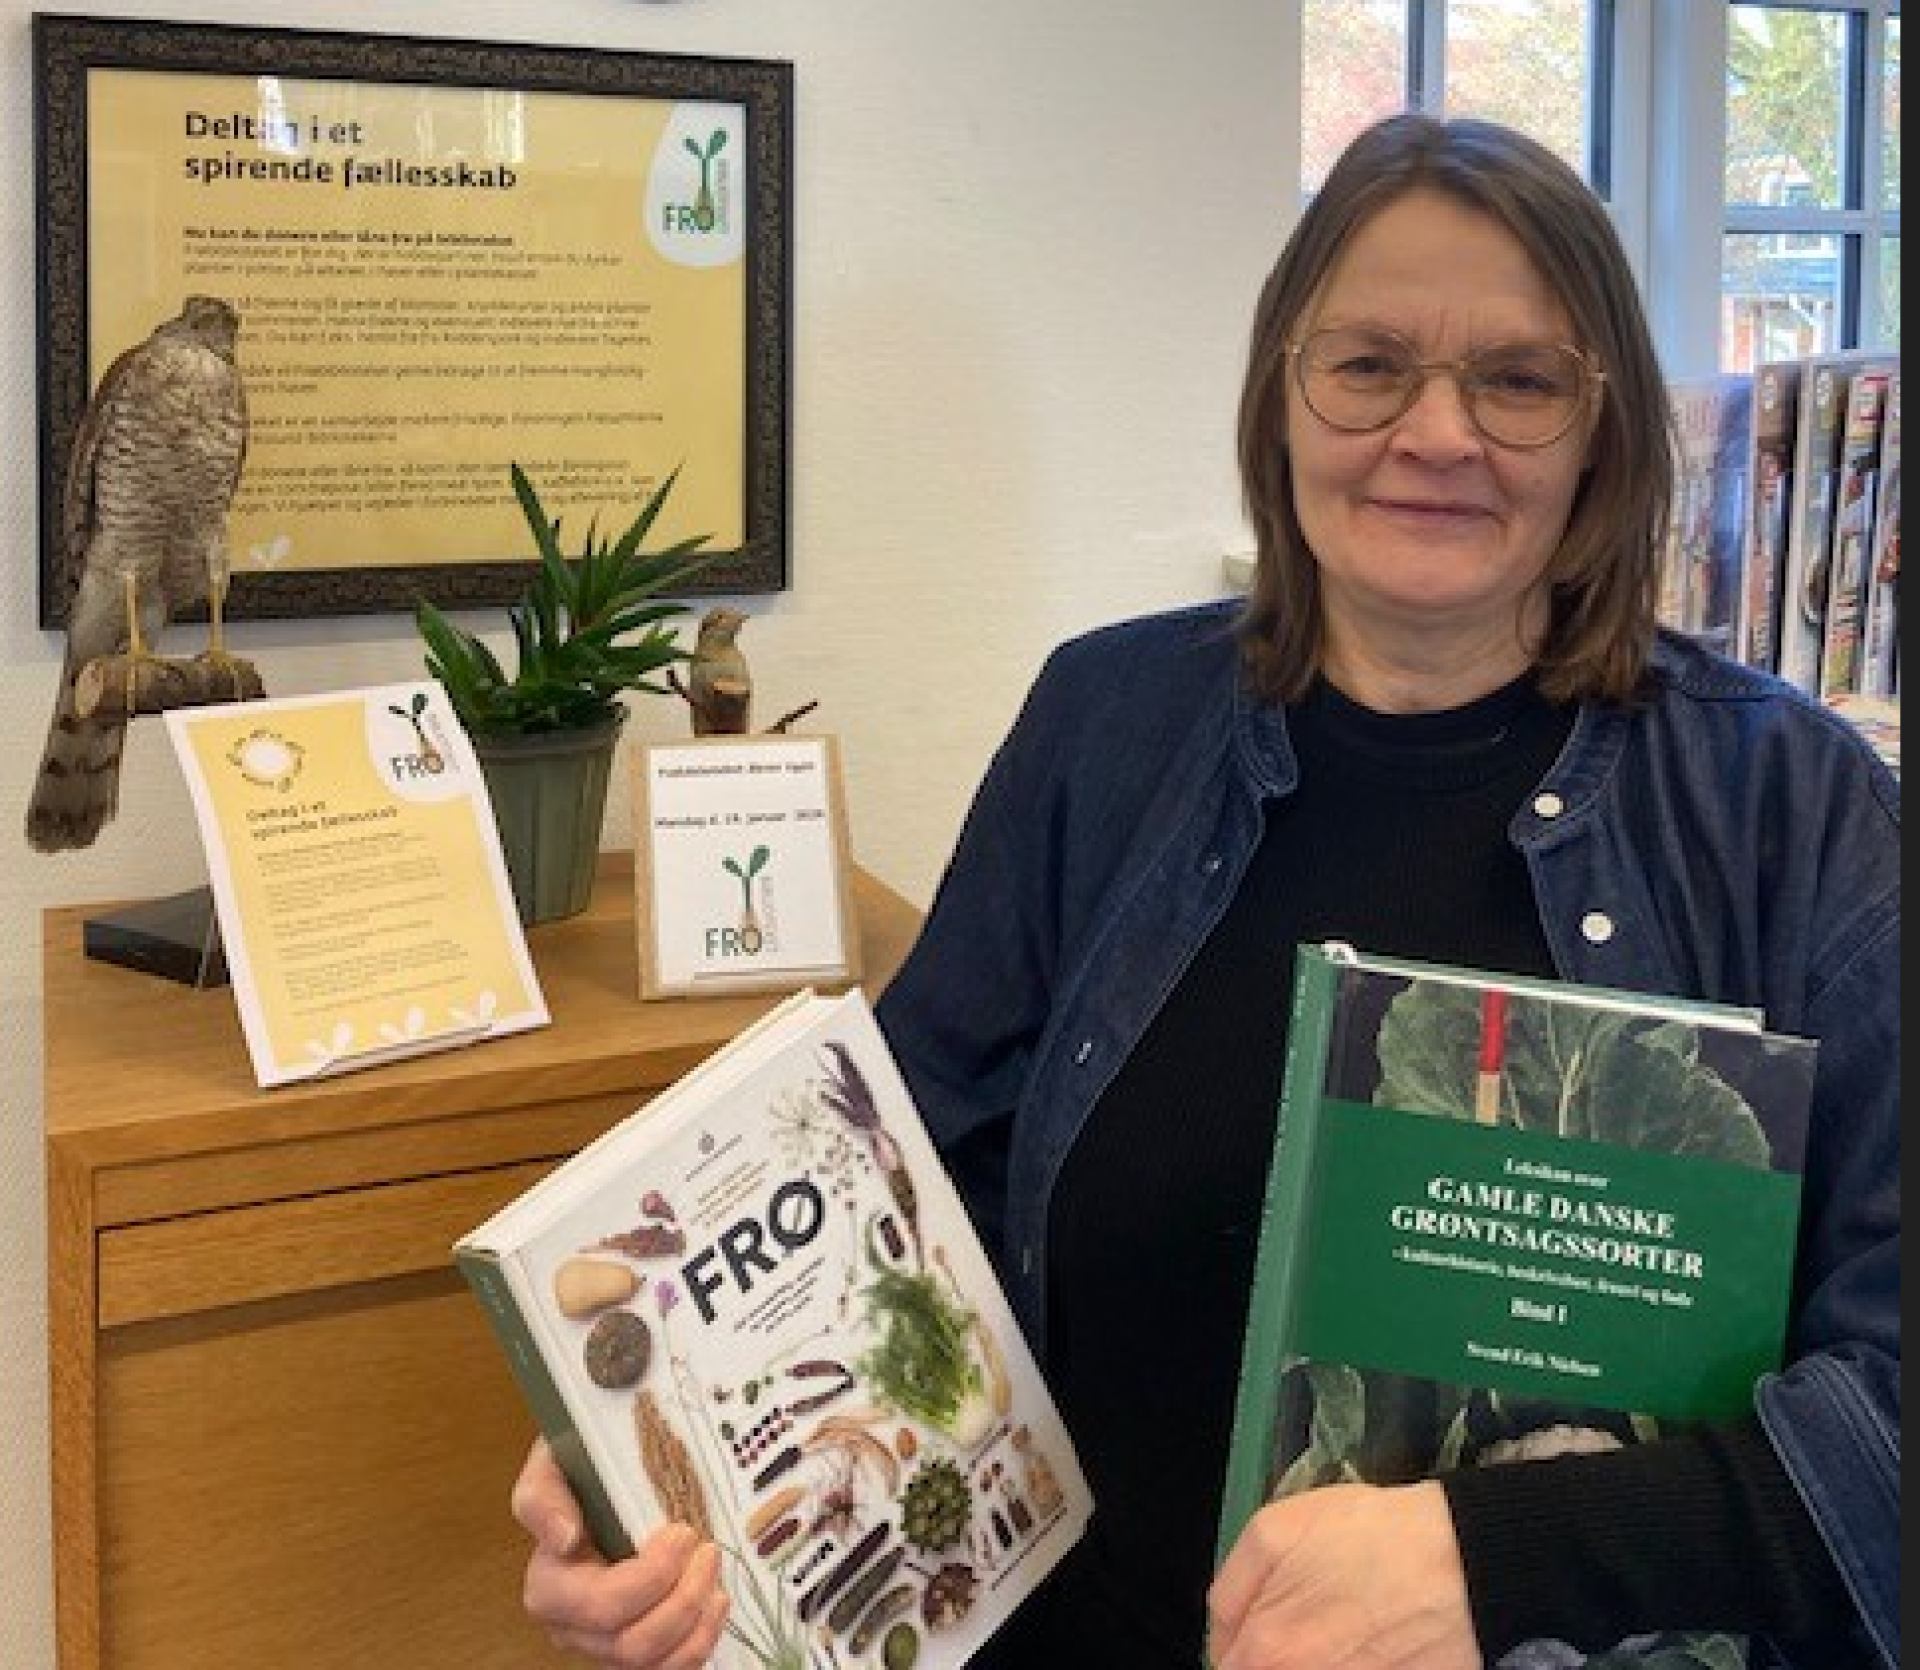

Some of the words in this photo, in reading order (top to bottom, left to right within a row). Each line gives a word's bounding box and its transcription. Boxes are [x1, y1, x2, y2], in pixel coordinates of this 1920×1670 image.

[311, 114, 320, 143] i
[329, 120, 363, 145] et
[185, 151, 333, 184] spirende
[343, 157, 517, 188] fællesskab
[1427, 1176, 1543, 1217] GAMLE
[1549, 1195, 1676, 1239] DANSKE
[1390, 1204, 1704, 1280] GRØNTSAGSSORTER
[1511, 1297, 1555, 1322] Bind
